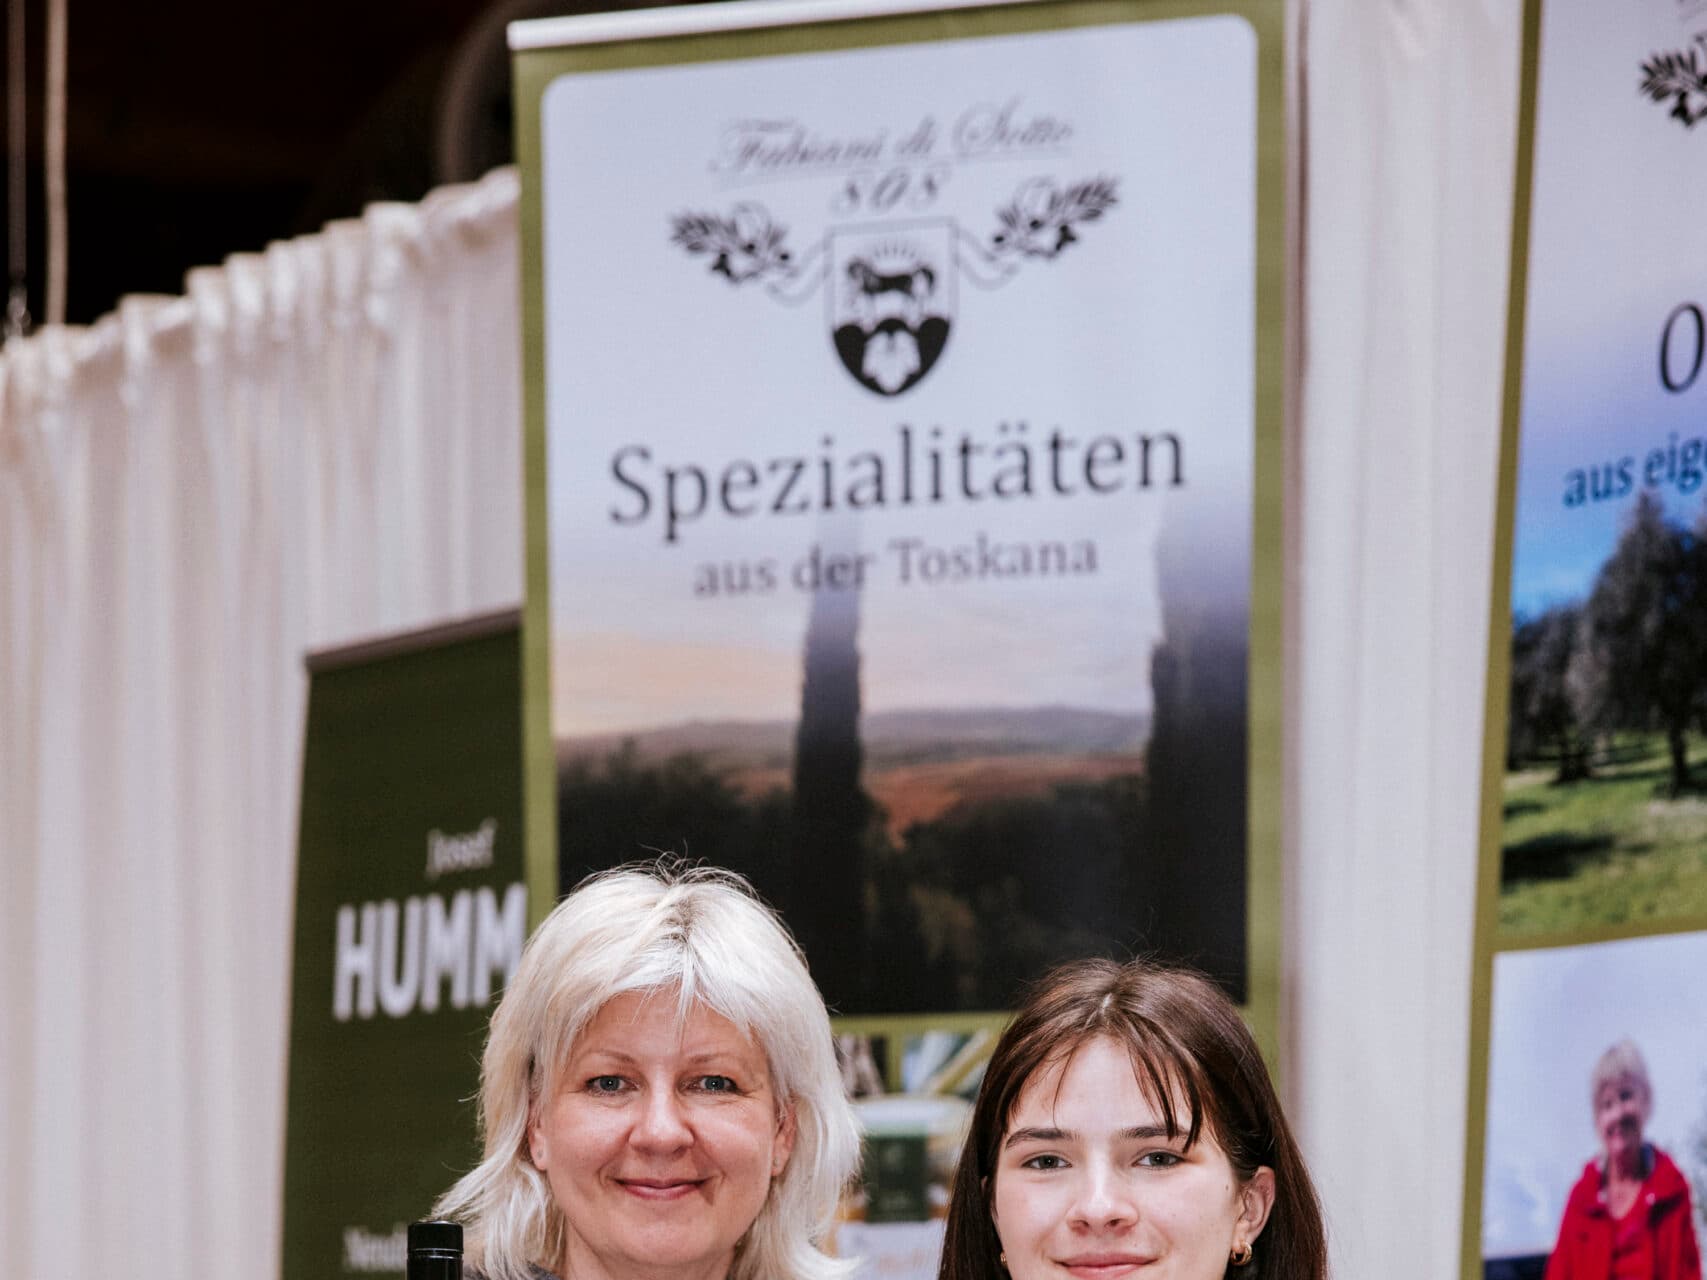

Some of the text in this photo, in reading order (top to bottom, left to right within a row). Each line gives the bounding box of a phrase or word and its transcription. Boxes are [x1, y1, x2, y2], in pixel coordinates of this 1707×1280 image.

[609, 420, 1188, 543] Spezialitäten
[1562, 430, 1707, 509] aus eig
[693, 531, 1100, 598] aus der Toskana
[333, 882, 528, 1022] HUMM
